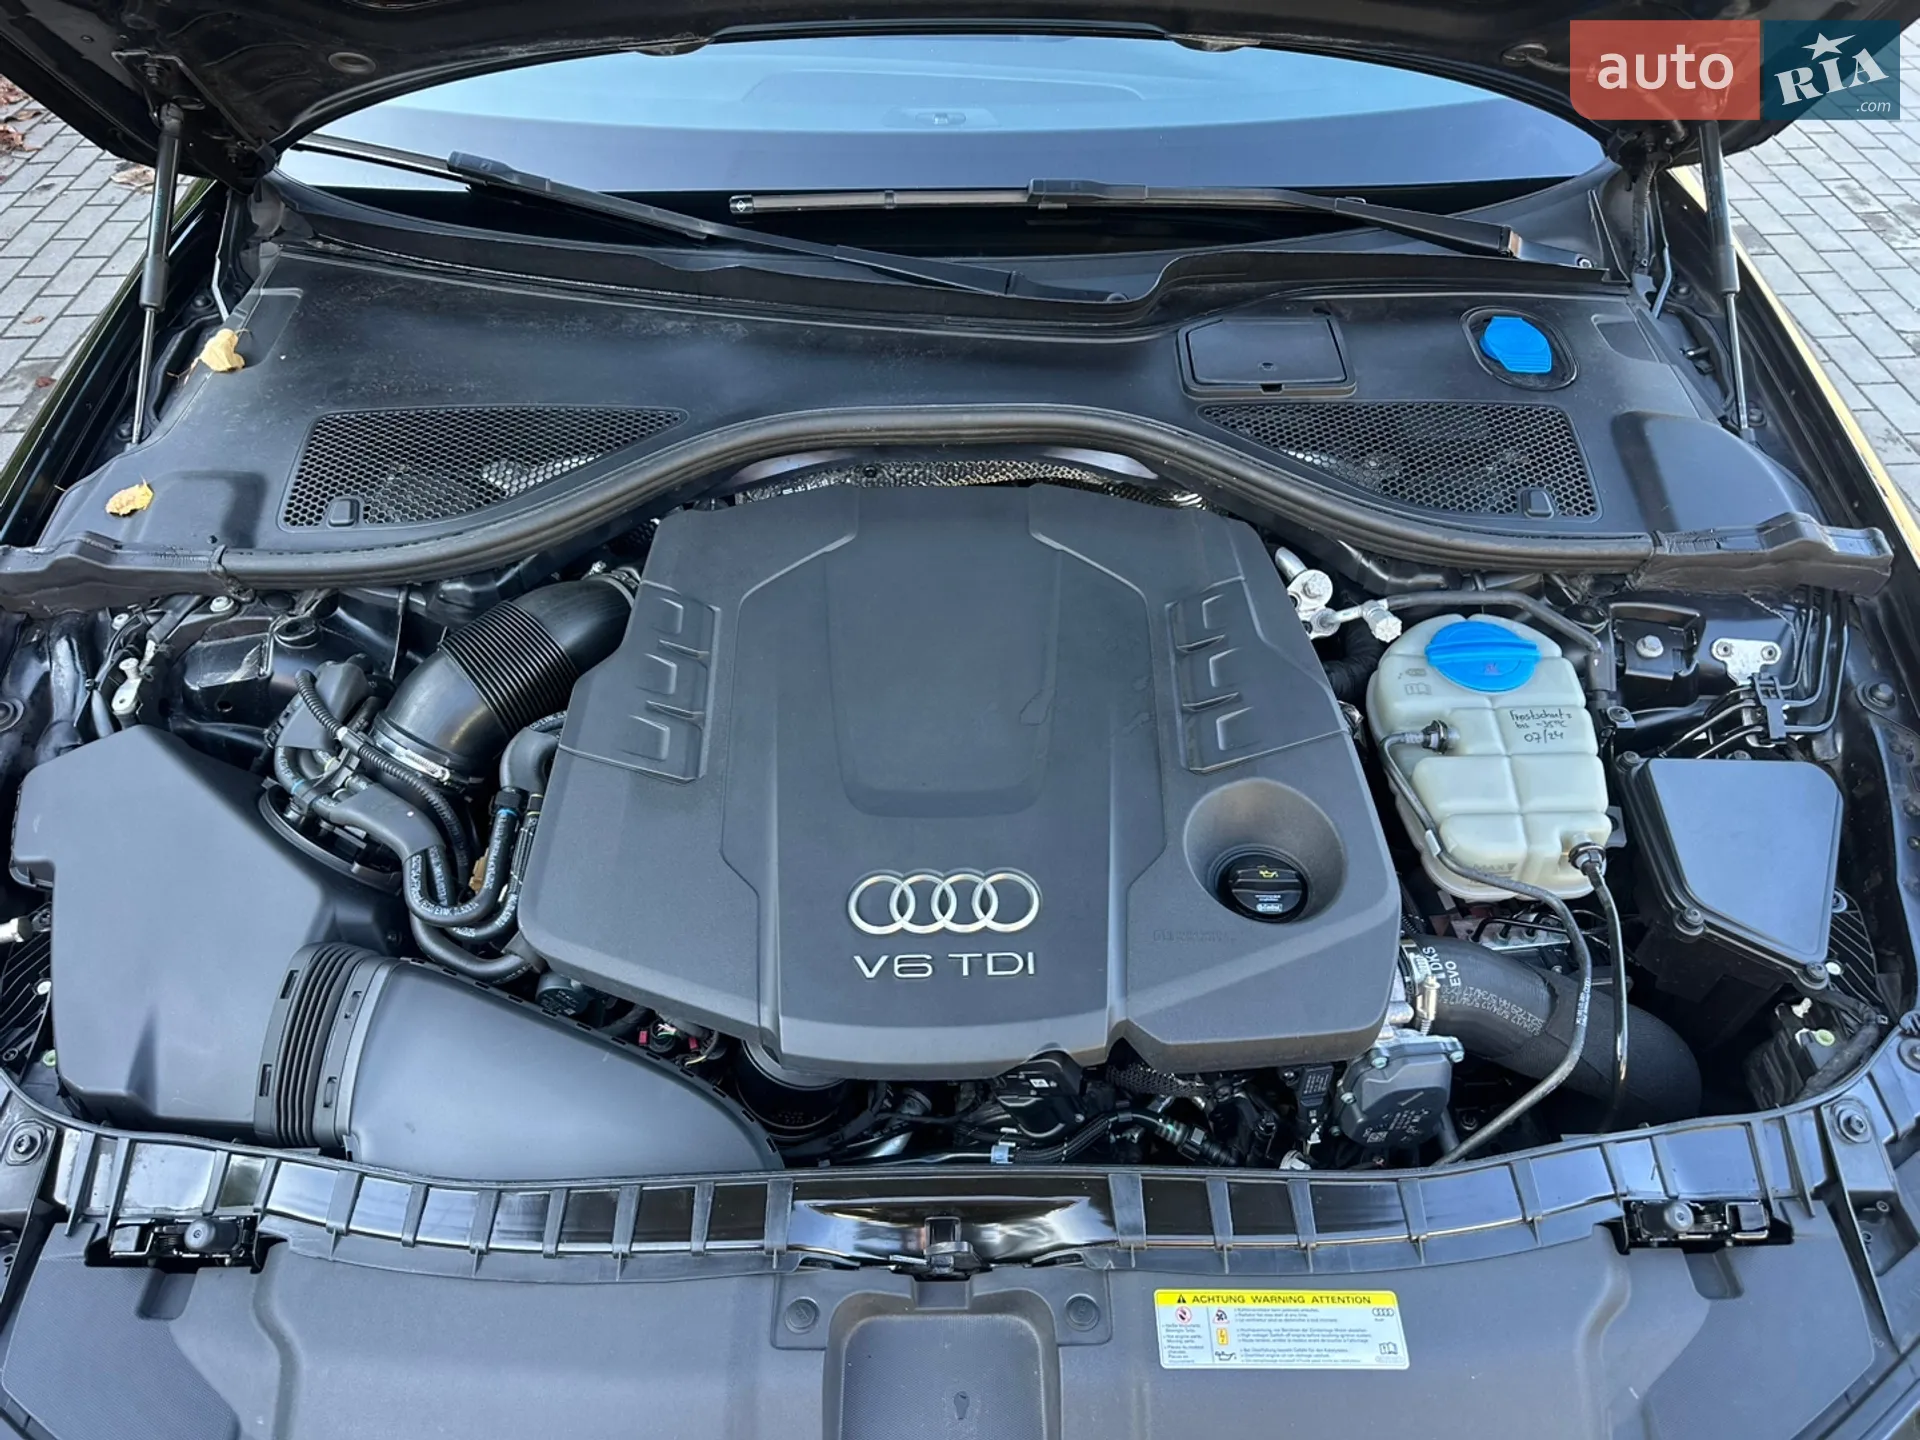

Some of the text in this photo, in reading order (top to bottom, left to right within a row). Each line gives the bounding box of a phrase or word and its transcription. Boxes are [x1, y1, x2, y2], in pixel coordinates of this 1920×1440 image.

[1524, 729, 1564, 744] 07/24
[853, 951, 1035, 979] V6 TDI
[1444, 961, 1461, 987] EVO
[1192, 1295, 1371, 1304] ACHTUNG WARNING ATTENTION
